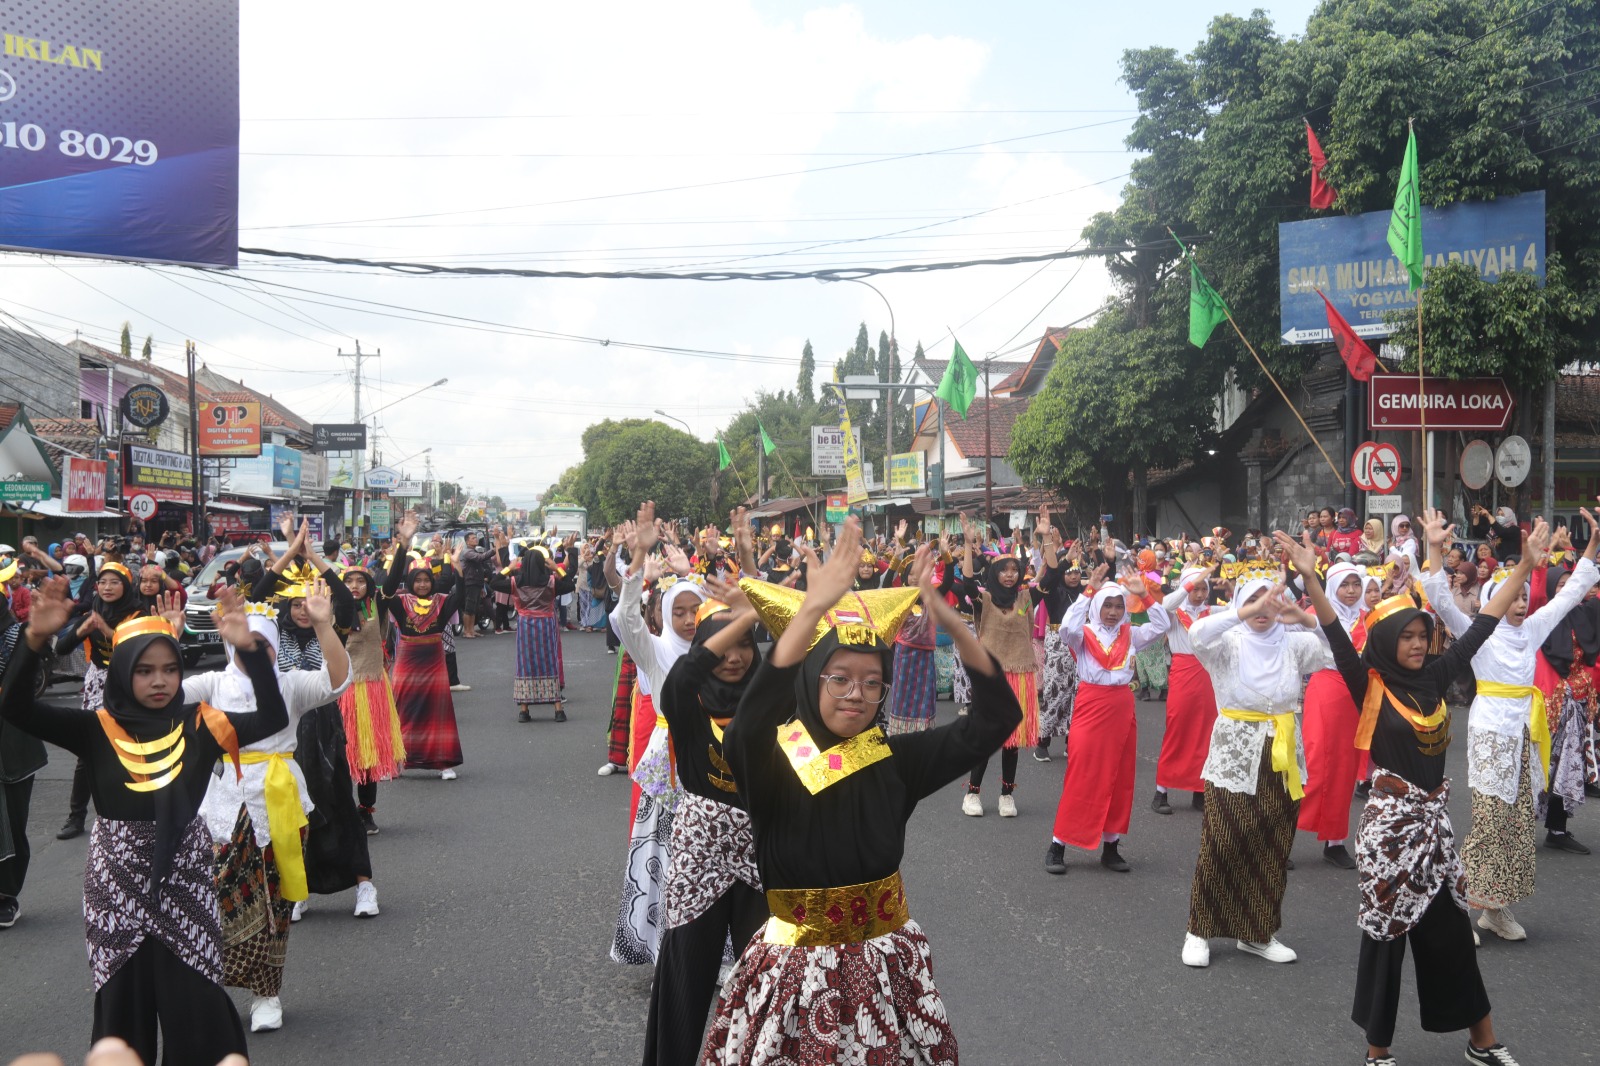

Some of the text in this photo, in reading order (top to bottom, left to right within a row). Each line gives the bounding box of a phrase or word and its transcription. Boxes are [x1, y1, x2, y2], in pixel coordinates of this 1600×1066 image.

[4, 33, 103, 72] IKLAN
[0, 121, 158, 166] 10 8029
[1288, 265, 1330, 294] SMA
[1523, 242, 1537, 272] 4
[1378, 394, 1504, 410] GEMBIRA LOKA
[817, 434, 858, 445] be BLS
[133, 450, 154, 465] DIGITAL
[155, 453, 178, 468] PRINTING
[70, 470, 106, 500] VAPENATION
[134, 500, 147, 512] 40
